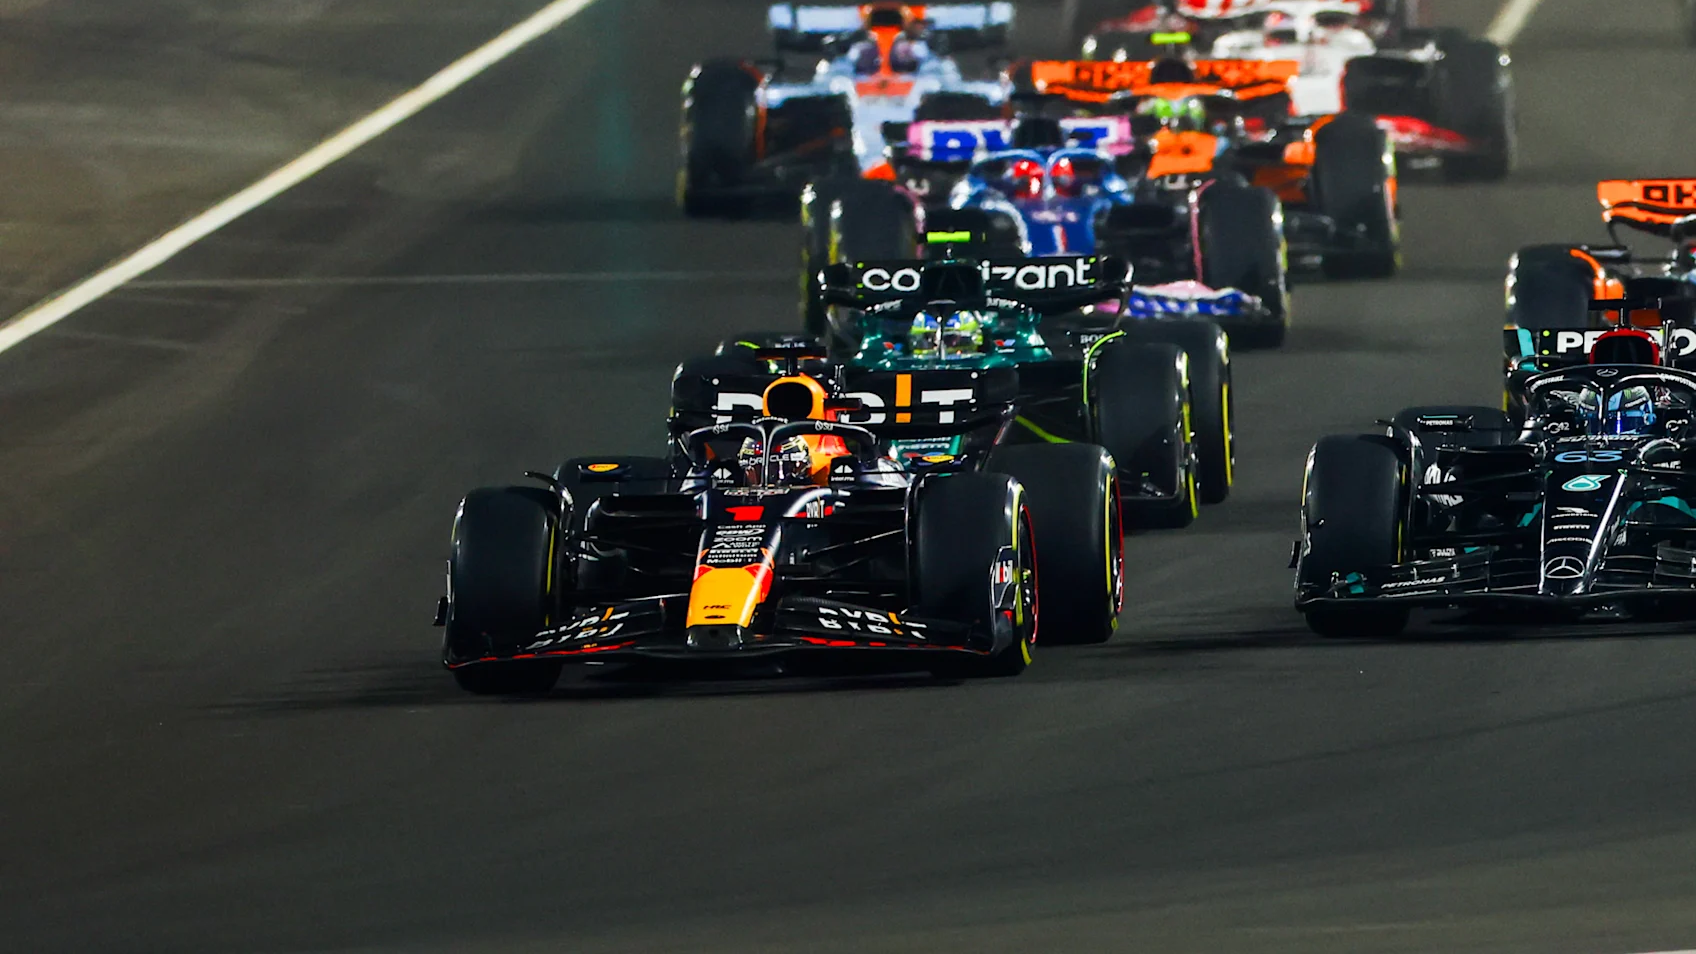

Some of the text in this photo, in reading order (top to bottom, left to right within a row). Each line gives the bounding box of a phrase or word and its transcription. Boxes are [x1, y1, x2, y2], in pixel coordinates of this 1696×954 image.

[862, 257, 1090, 291] coizant
[1554, 450, 1623, 463] 63
[1380, 576, 1446, 589] PETRONAS
